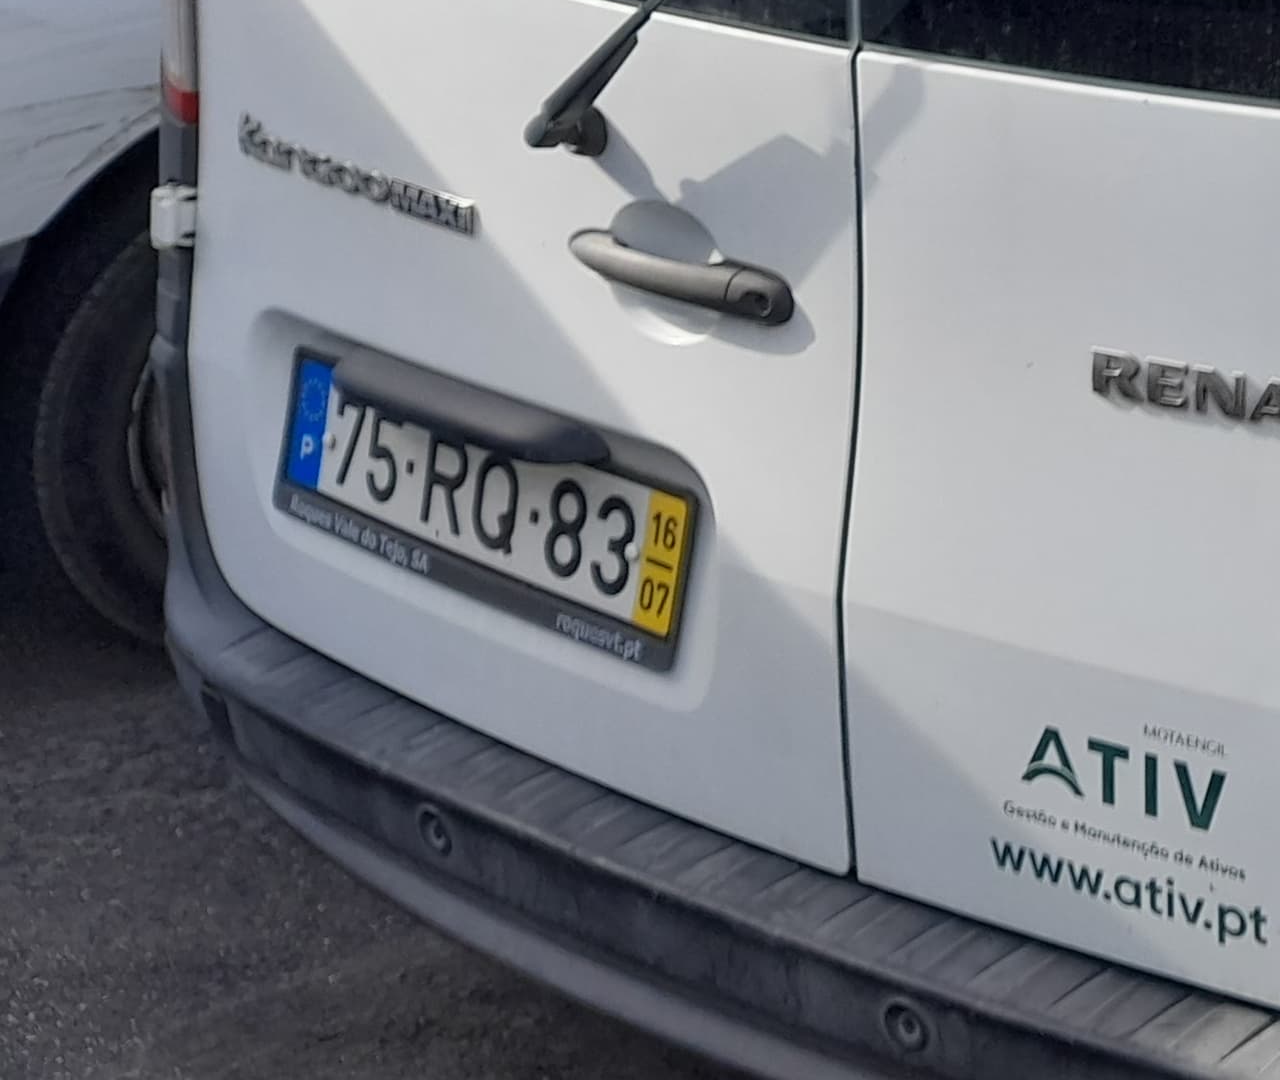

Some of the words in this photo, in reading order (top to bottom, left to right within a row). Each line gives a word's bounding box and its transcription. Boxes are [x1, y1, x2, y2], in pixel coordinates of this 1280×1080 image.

[301, 434, 315, 460] P
[652, 511, 678, 551] 16
[639, 577, 670, 619] 07
[1021, 724, 1227, 832] ATIV
[1003, 800, 1057, 828] Gestão
[1061, 818, 1070, 832] e
[1074, 821, 1169, 861] Manutenção
[1173, 848, 1194, 866] de
[1198, 852, 1247, 881] Ativos
[991, 836, 1268, 944] www.ativ.pt
